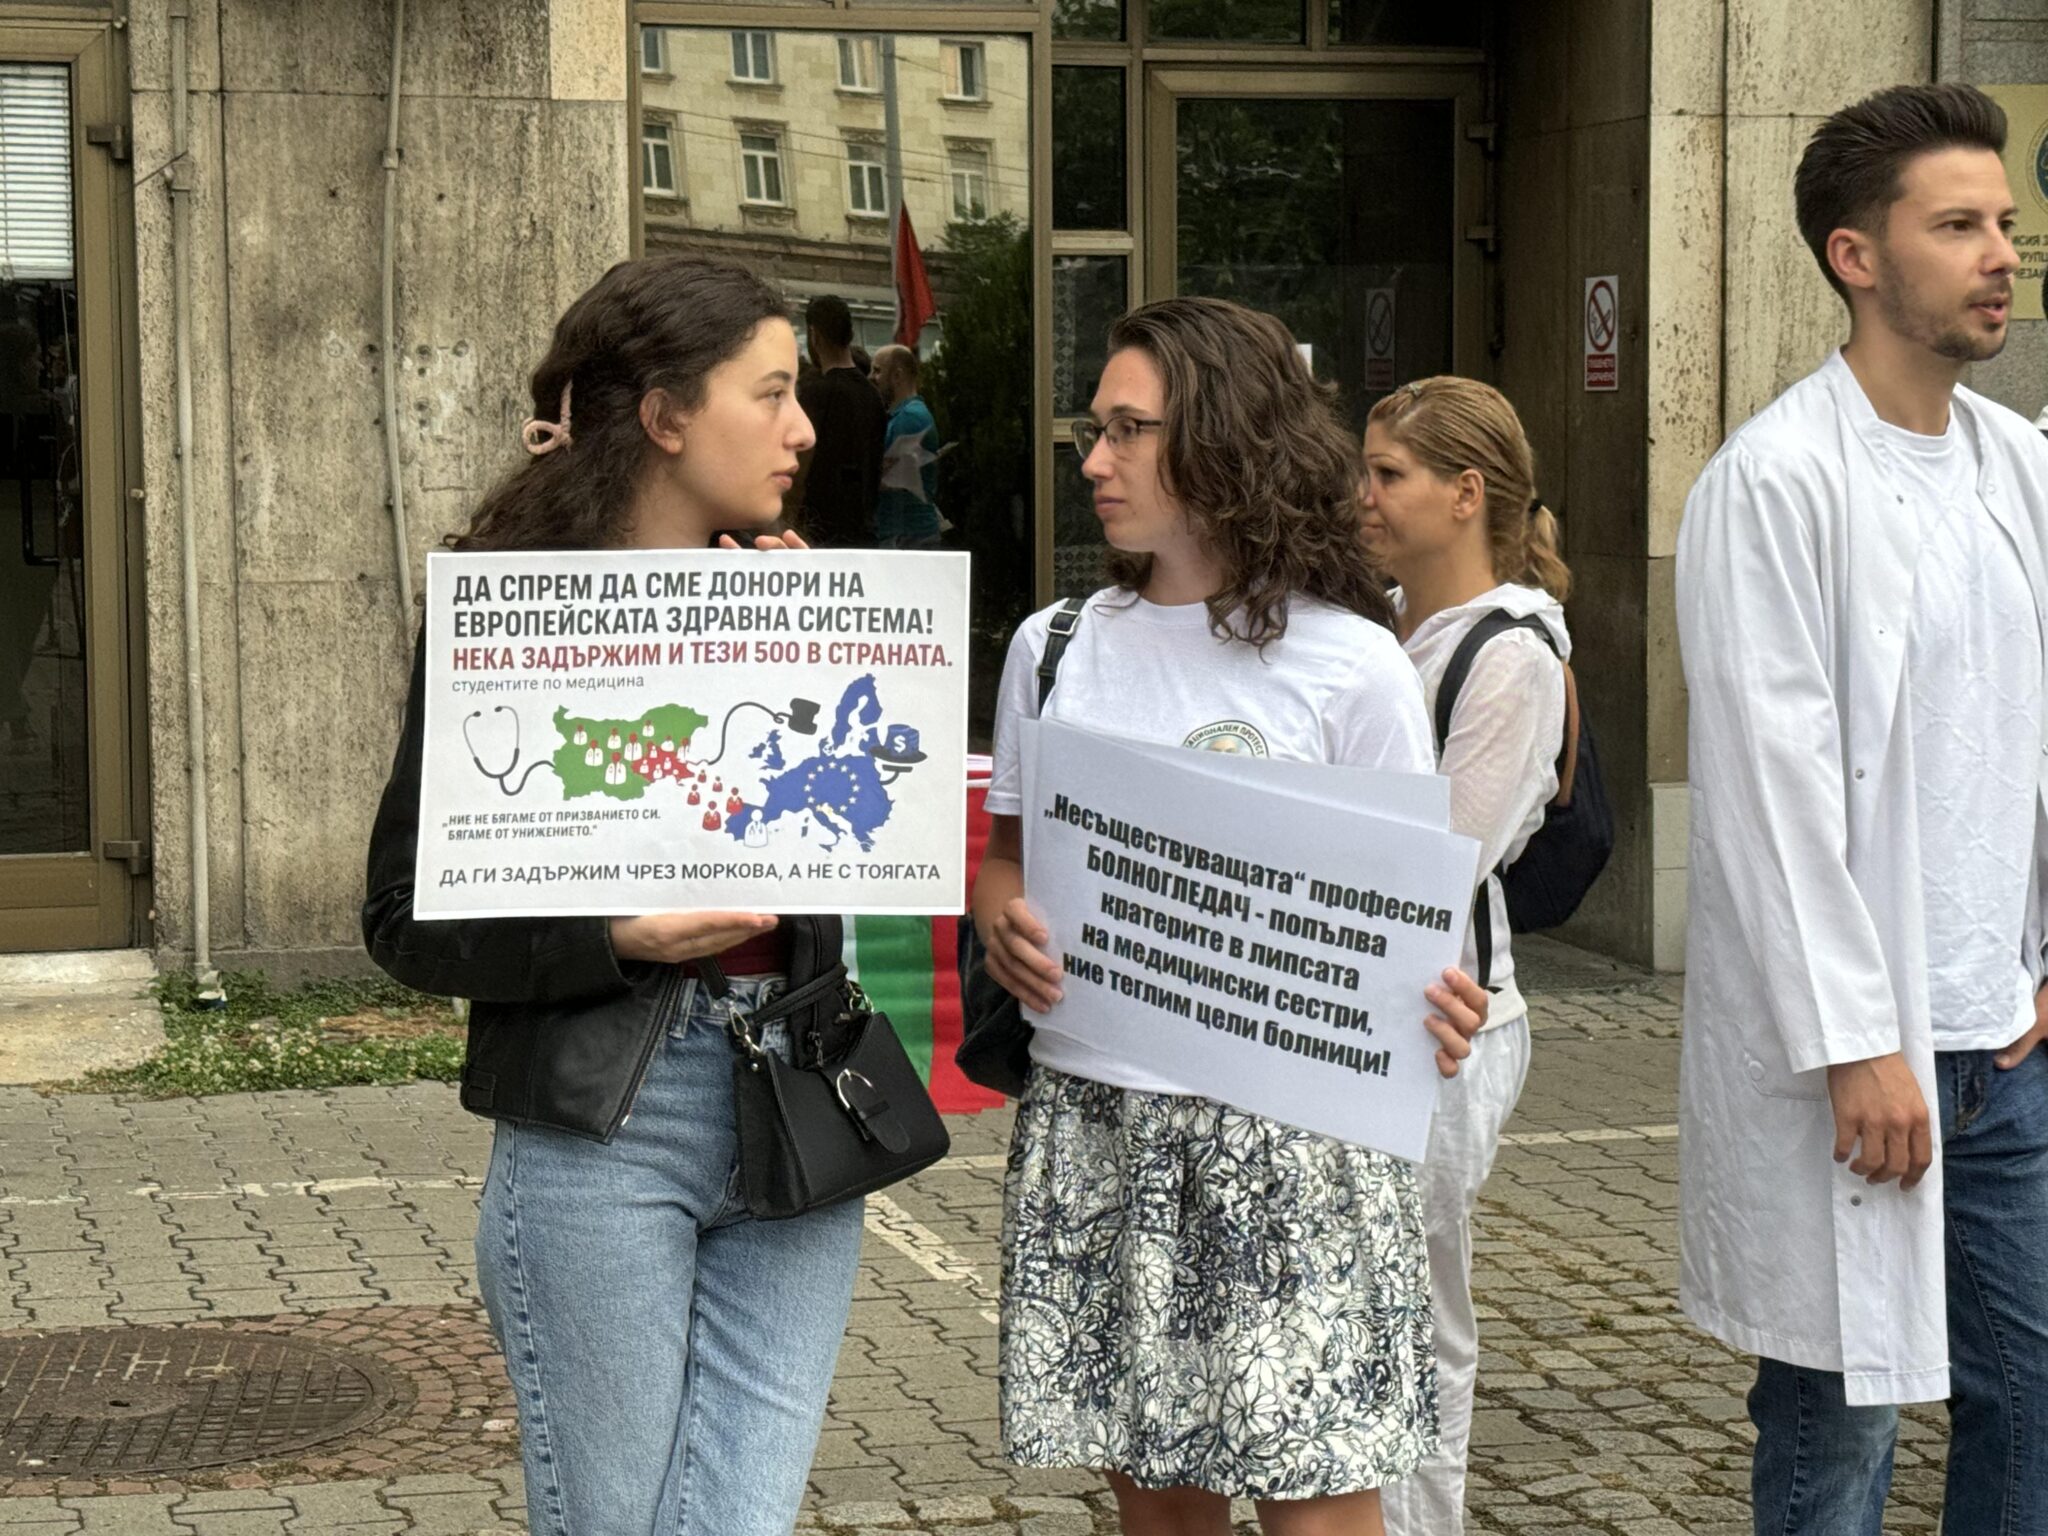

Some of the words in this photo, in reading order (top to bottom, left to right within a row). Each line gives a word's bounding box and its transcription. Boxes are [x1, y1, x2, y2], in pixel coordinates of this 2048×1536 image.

[453, 575, 492, 607] ДА
[499, 573, 592, 602] СПРЕМ
[599, 573, 638, 603] ДА
[645, 571, 702, 599] СМЕ
[707, 571, 821, 601] ДОНОРИ
[829, 572, 865, 598] НА
[454, 603, 659, 638] ЕВРОПЕЙСКАТА
[666, 605, 791, 637] ЗДРАВНА
[798, 605, 933, 635] СИСТЕМА!
[453, 647, 515, 671] НЕКА
[521, 643, 661, 672] ЗАДЪРЖИМ
[669, 642, 683, 665] И
[690, 641, 747, 664] ТЕЗИ
[755, 641, 800, 663] 500
[807, 641, 821, 664] В
[828, 642, 953, 667] СТРАНАТА.
[451, 679, 539, 695] студентите
[543, 678, 562, 690] по
[566, 676, 645, 691] медицина
[1186, 724, 1240, 749] АЦИОНАЛЕН
[1240, 726, 1265, 756] ПРОТЕСТ
[442, 814, 471, 827] „НИЕ
[474, 814, 489, 825] НЕ
[491, 812, 535, 824] БЯГАМЕ
[538, 811, 552, 823] ОТ
[555, 809, 639, 822] ПРИЗВАНИЕТО
[642, 809, 661, 820] СИ.
[447, 828, 491, 841] БЯГАМЕ
[495, 828, 509, 839] ОТ
[512, 825, 597, 839] УНИЖЕНИЕТО.“
[439, 869, 467, 887] ДА
[473, 868, 496, 883] ГИ
[502, 865, 620, 884] ЗАДЪРЖИМ
[626, 863, 676, 880] ЧРЕЗ
[681, 863, 783, 881] МОРКОВА,
[788, 863, 801, 878] А
[808, 863, 832, 879] НЕ
[838, 864, 851, 879] С
[856, 864, 941, 879] ТОЯГАТА
[1043, 793, 1306, 895] „Несъществуващата“
[1309, 879, 1453, 933] професия
[1087, 843, 1251, 923] БОЛНОГЛЕДАЧ
[1268, 908, 1387, 958] попълва
[1100, 891, 1225, 953] кратерите
[1228, 935, 1244, 959] в
[1247, 942, 1360, 991] липсата
[1081, 922, 1109, 953] на
[1113, 934, 1270, 1007] медицински
[1274, 989, 1374, 1037] сестри,
[1062, 951, 1105, 986] ние
[1108, 969, 1192, 1019] теглим
[1195, 1001, 1259, 1041] цели
[1263, 1019, 1391, 1078] болници!
